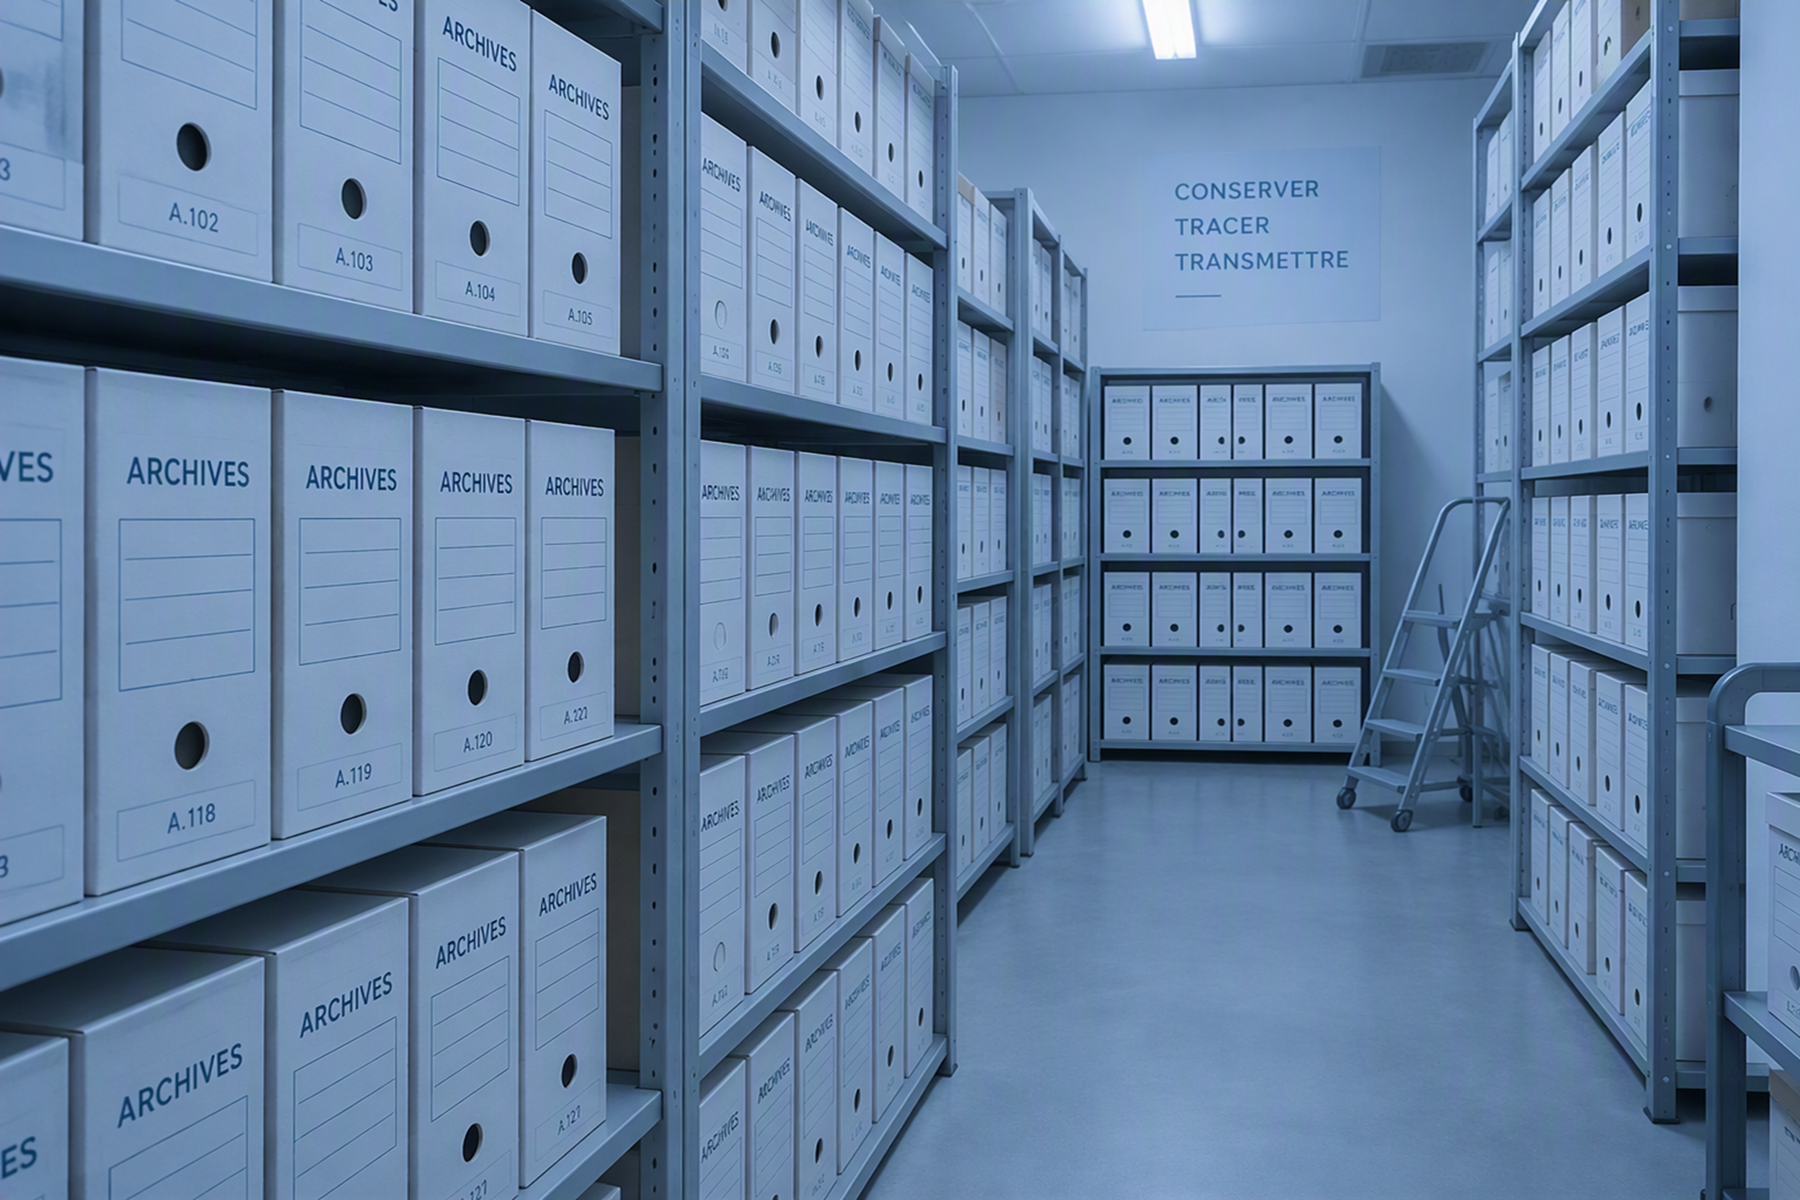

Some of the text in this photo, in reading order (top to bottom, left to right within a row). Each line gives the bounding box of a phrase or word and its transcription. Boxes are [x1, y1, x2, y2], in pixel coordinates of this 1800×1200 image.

[442, 16, 517, 72] ARCHIVES
[548, 74, 610, 121] ARCHIVES
[1175, 180, 1319, 200] CONSERVER
[168, 202, 219, 233] A.102
[1175, 216, 1270, 236] TRACER
[335, 247, 374, 272] A.103
[1175, 250, 1349, 271] TRANSMETTRE
[465, 281, 496, 301] A.104
[568, 308, 593, 326] A.105
[127, 457, 250, 487] ARCHIVES
[306, 465, 397, 492] ARCHIVES
[440, 471, 513, 495] ARCHIVES
[545, 476, 604, 497] ARCHIVES
[702, 484, 740, 501] ARCHIVES
[463, 731, 493, 754] A.120
[335, 763, 372, 788] A.119
[167, 803, 216, 834] A.118
[701, 800, 740, 833] ARCHIVES
[538, 873, 598, 917] ARCHIVES
[435, 916, 507, 969] ARCHIVES
[300, 971, 393, 1038] ARCHIVES
[117, 1043, 243, 1128] ARCHIVES
[557, 1105, 581, 1136] A.127
[1, 1136, 38, 1179] ES
